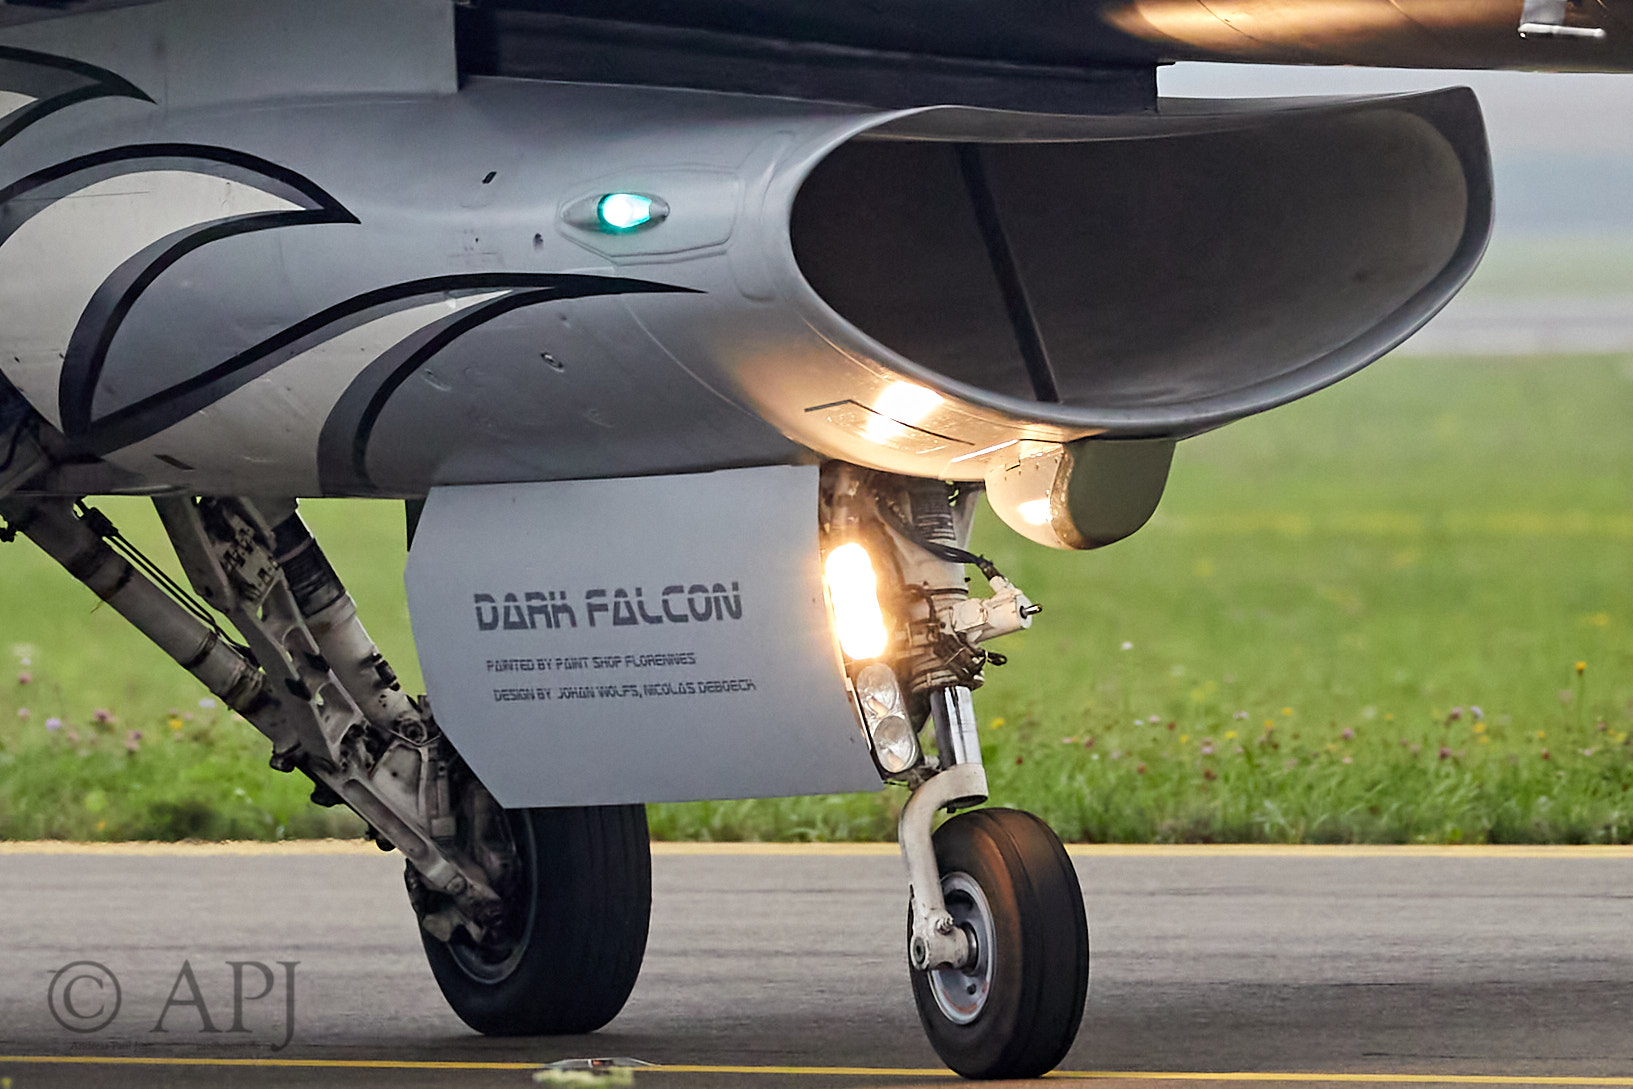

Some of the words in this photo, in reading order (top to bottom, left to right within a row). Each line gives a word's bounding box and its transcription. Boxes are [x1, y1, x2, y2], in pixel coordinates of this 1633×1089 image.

[474, 591, 577, 631] DARK
[585, 581, 742, 627] FALCON
[487, 660, 535, 672] PAINTED
[536, 658, 552, 670] BY
[555, 658, 588, 670] PAINT
[592, 656, 622, 668] SHOP
[624, 652, 697, 668] FLORENNES
[493, 688, 536, 702] DESIGN
[536, 688, 551, 700] BY
[557, 687, 595, 699] JOHAN
[643, 682, 696, 696] NICOLAS
